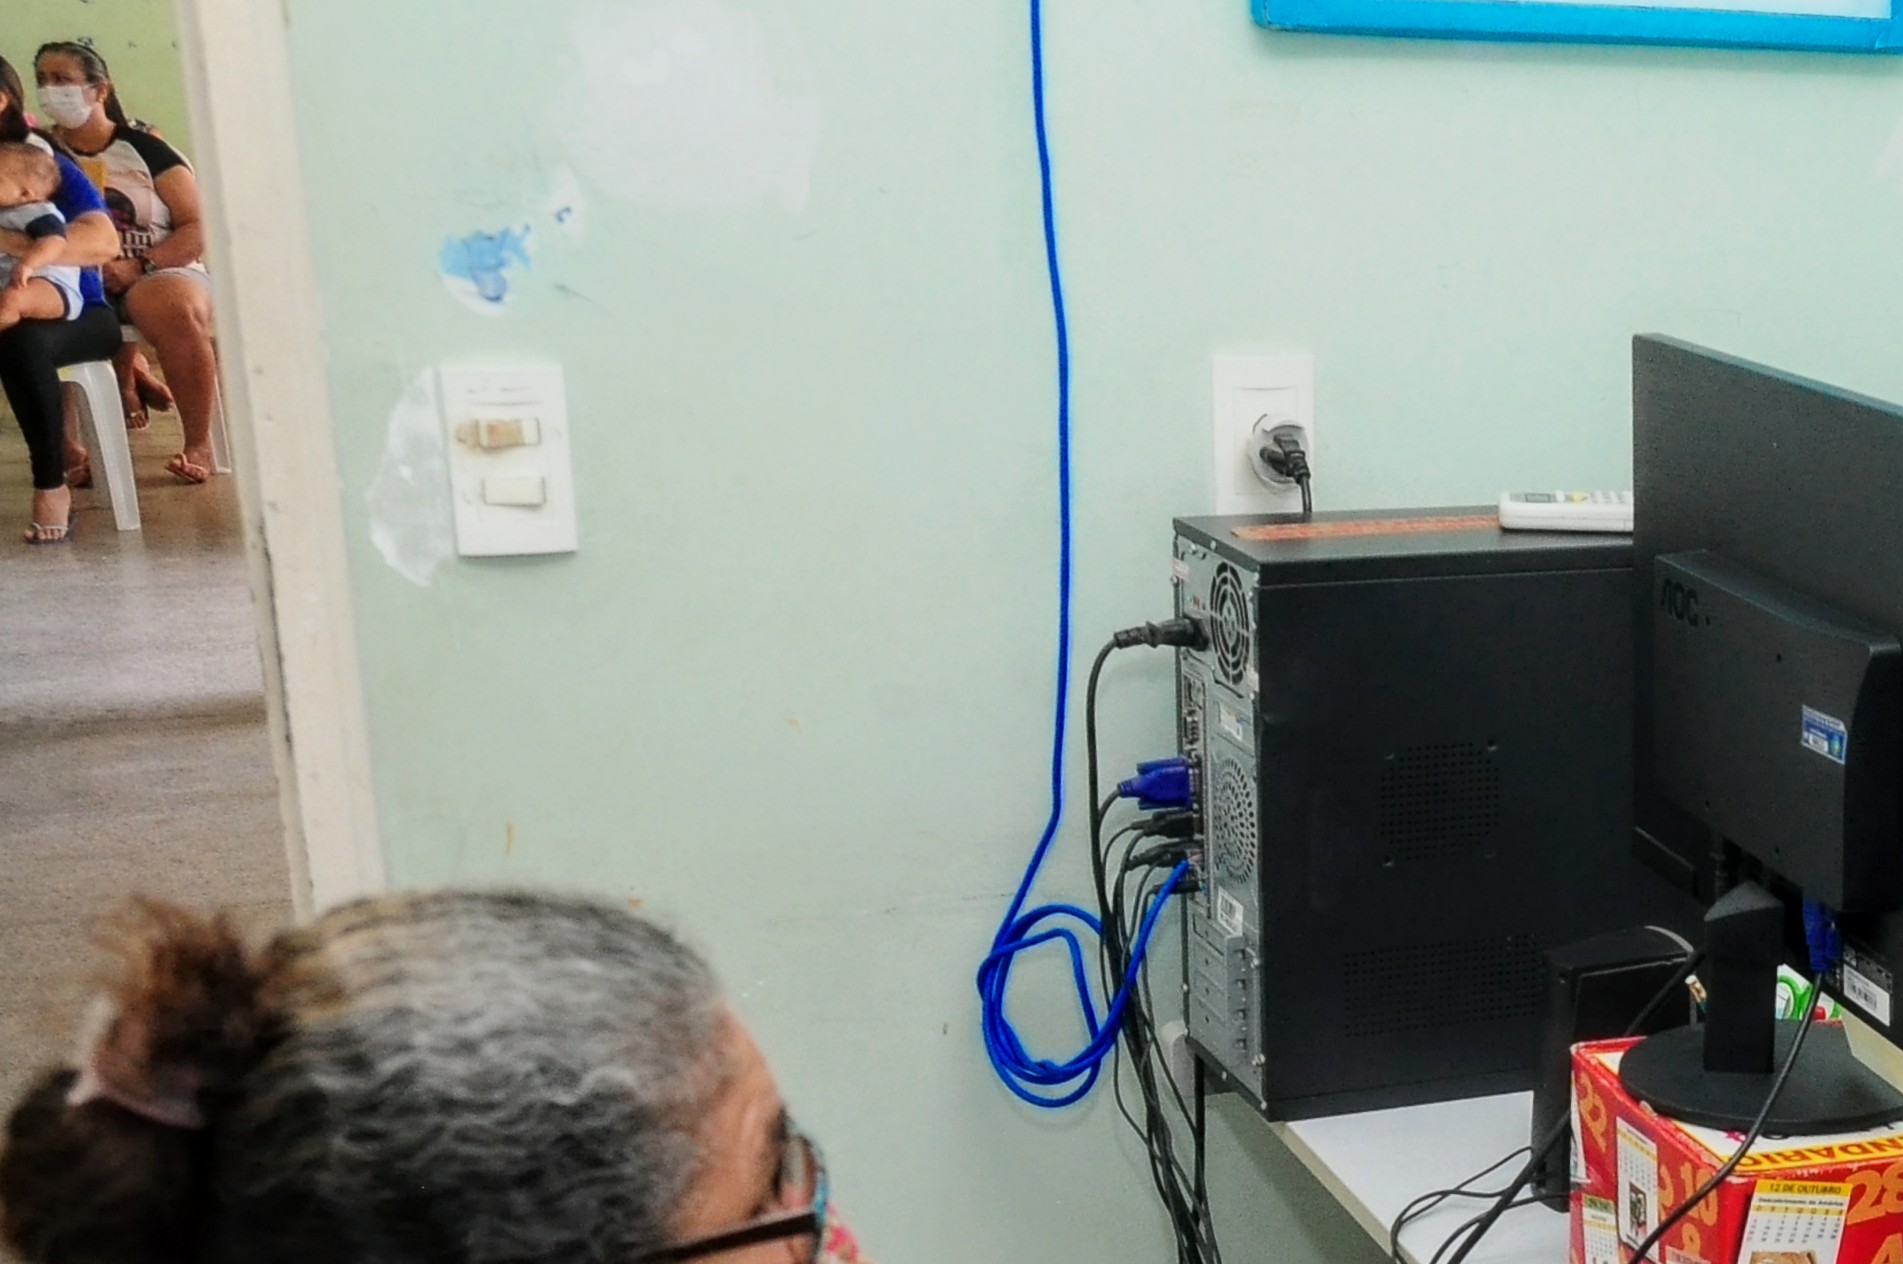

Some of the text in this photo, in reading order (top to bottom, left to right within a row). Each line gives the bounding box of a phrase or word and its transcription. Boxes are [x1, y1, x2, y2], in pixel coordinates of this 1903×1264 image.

[1680, 1162, 1718, 1226] 10
[1782, 1184, 1795, 1193] DE
[1797, 1184, 1842, 1194] OUTUBRO
